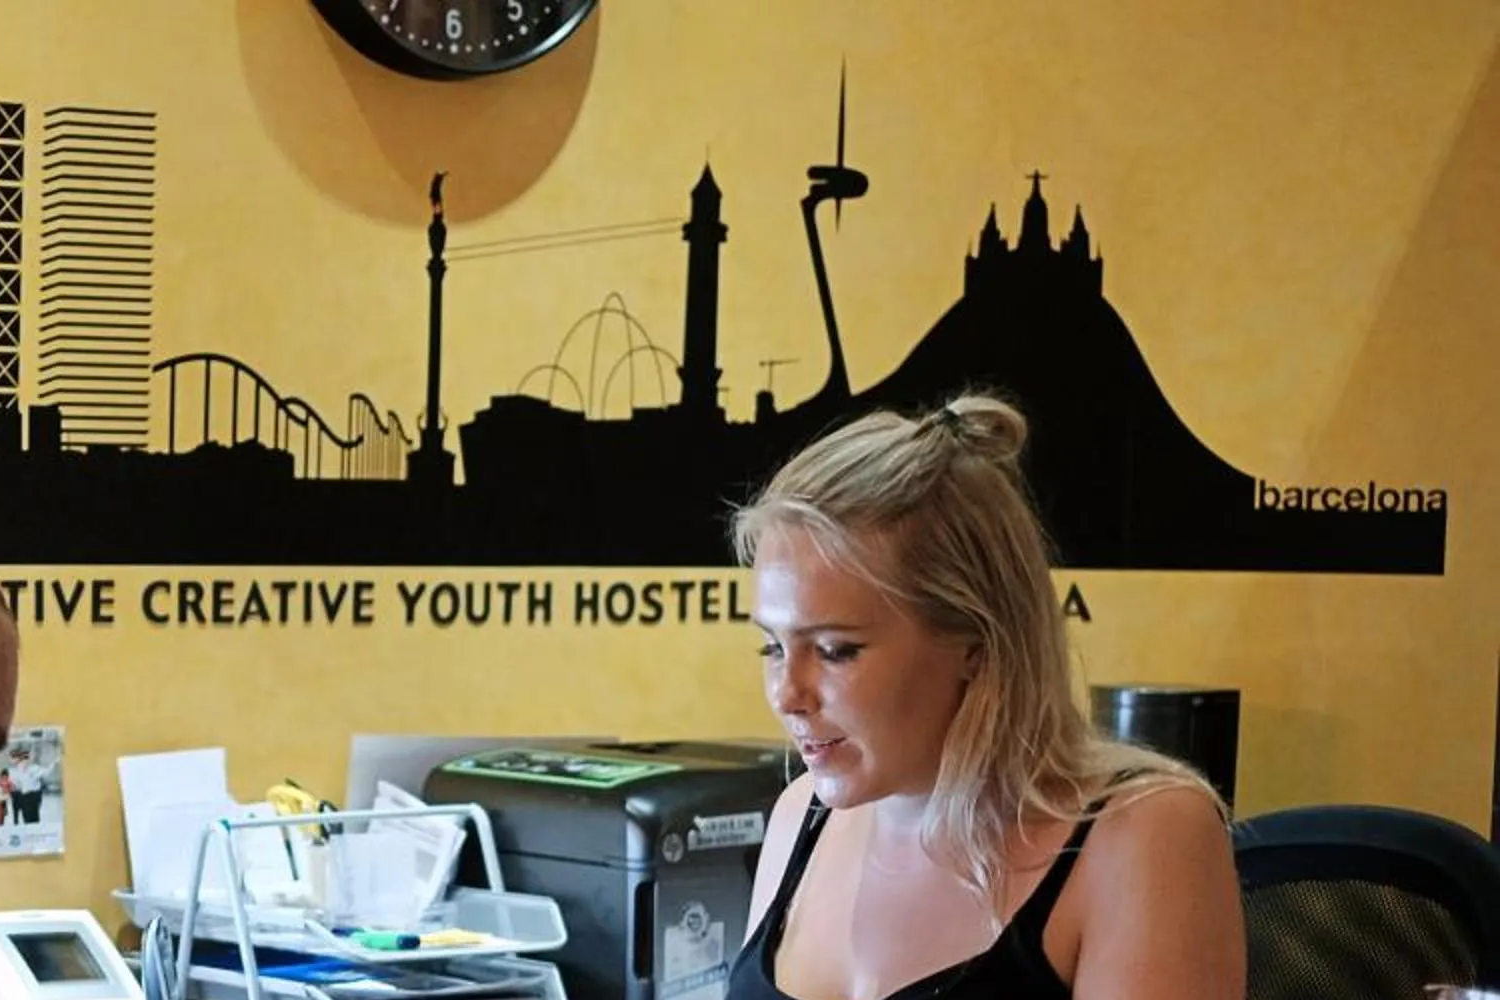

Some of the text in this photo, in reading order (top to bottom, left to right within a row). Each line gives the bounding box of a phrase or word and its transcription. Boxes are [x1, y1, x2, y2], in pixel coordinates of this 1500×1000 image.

[446, 9, 462, 39] 6
[1258, 479, 1447, 512] barcelona
[141, 580, 375, 625] CREATIVE
[396, 581, 553, 626] YOUTH
[574, 580, 750, 625] HOSTEL
